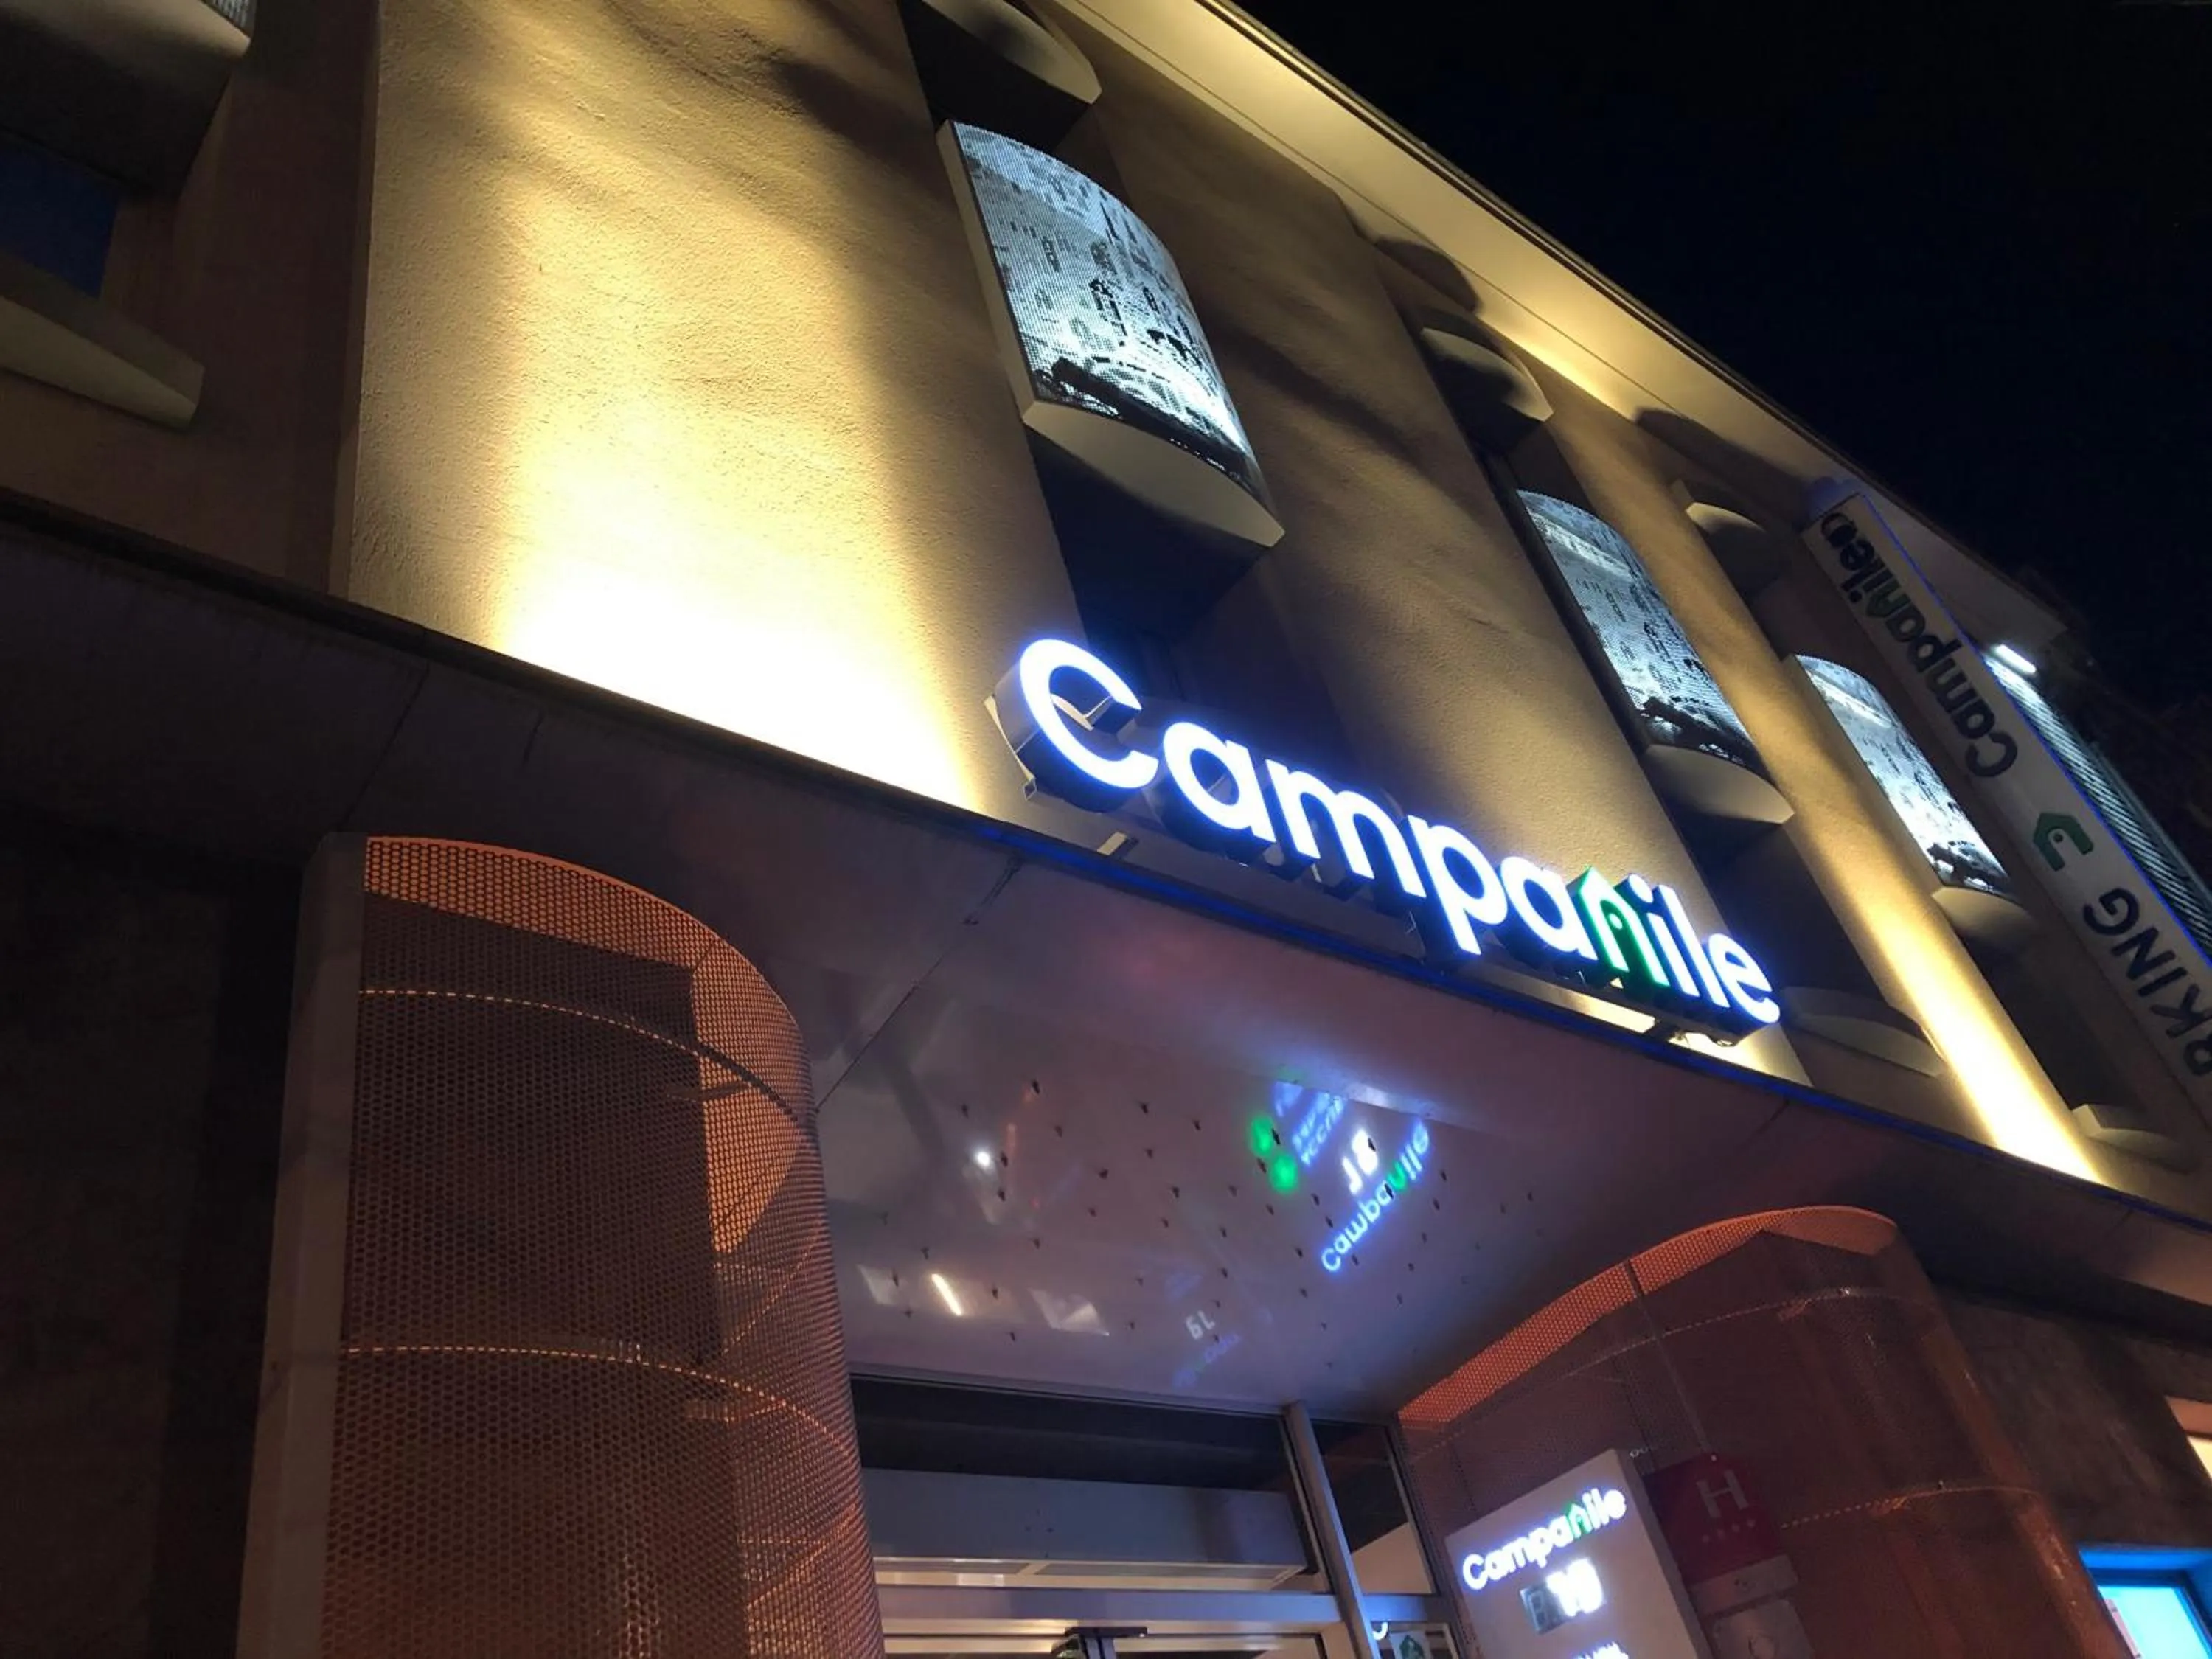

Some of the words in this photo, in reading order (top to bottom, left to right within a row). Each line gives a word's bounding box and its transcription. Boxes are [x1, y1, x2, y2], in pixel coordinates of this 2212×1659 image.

[1837, 538, 2018, 779] Campanile
[1019, 639, 1780, 1023] Campanile
[1462, 1487, 1627, 1591] Campanile
[1696, 1469, 1749, 1518] H
